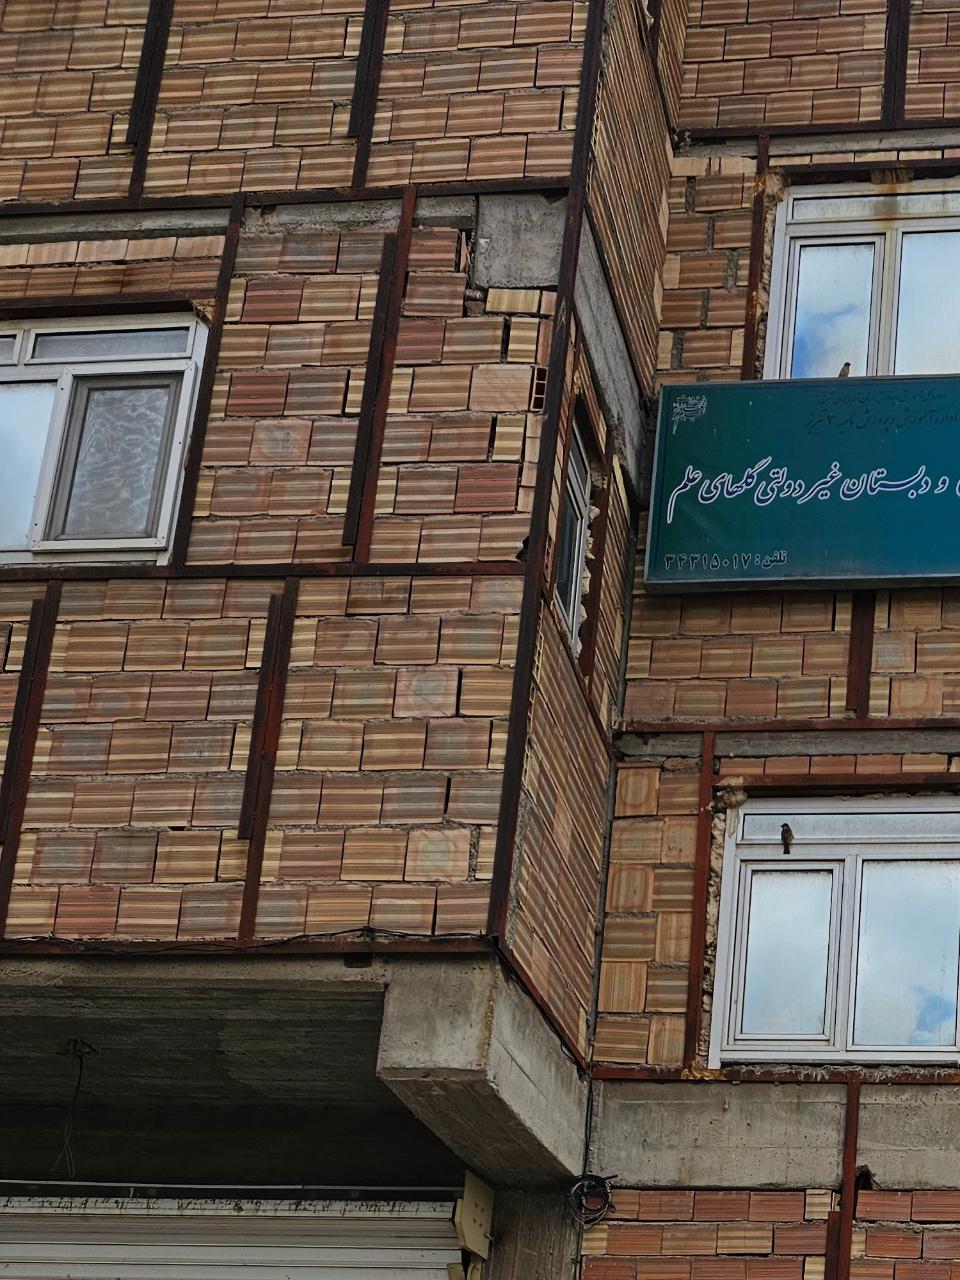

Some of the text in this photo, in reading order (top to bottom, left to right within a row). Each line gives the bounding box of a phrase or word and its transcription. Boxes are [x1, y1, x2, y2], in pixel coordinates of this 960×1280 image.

[666, 465, 703, 524] علم
[840, 465, 932, 501] دبستان
[934, 475, 949, 494] و
[664, 553, 752, 571] ۳۴۳۱۵۰۱۷
